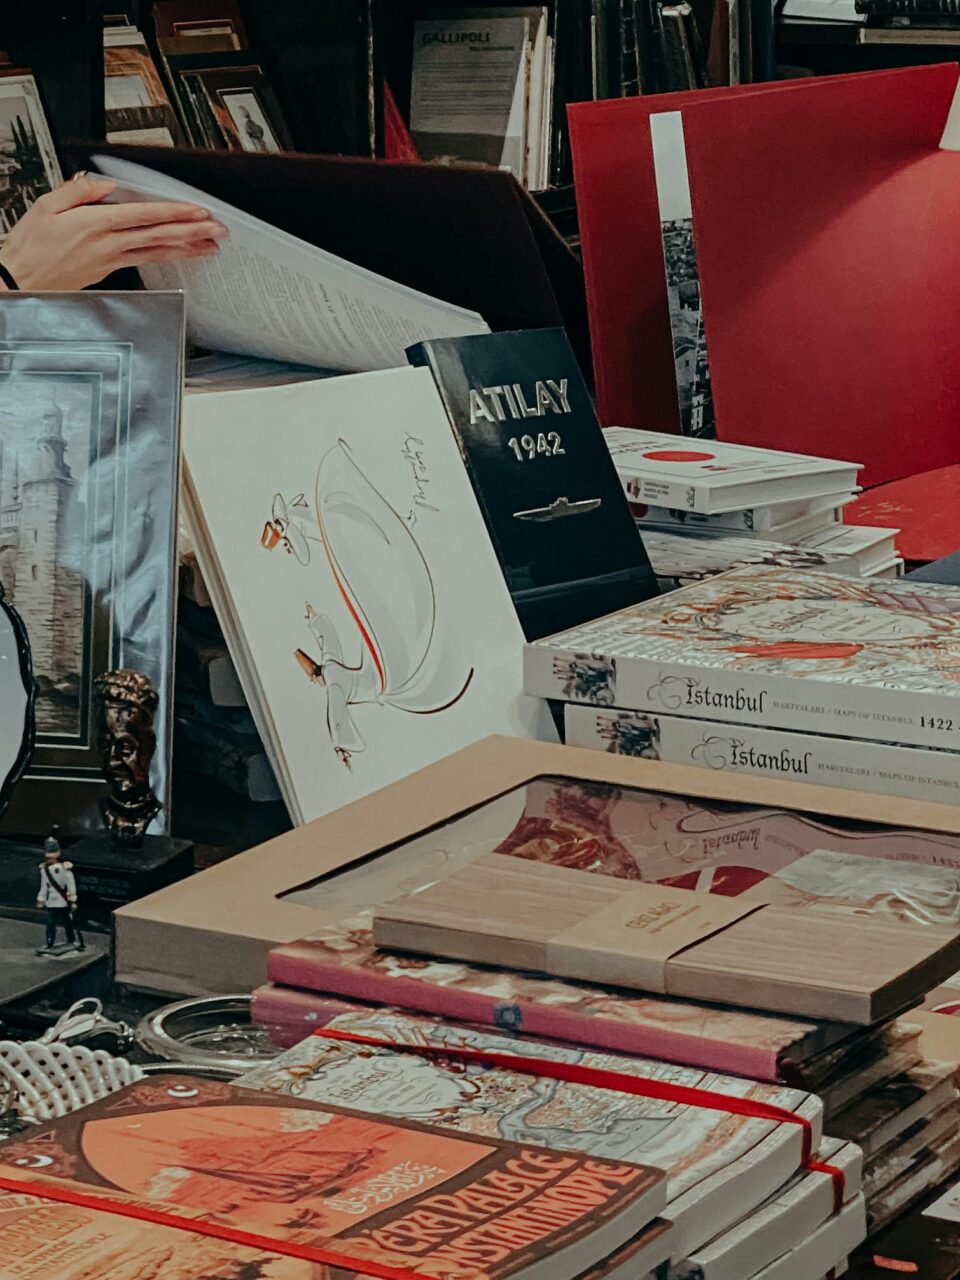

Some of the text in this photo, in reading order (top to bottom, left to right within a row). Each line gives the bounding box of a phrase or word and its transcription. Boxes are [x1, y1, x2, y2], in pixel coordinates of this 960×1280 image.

[422, 31, 490, 44] GALLIPOLI
[468, 378, 570, 425] ATILAY
[507, 431, 567, 462] 1942
[920, 716, 954, 731] 1422
[414, 1149, 581, 1220] PALACE
